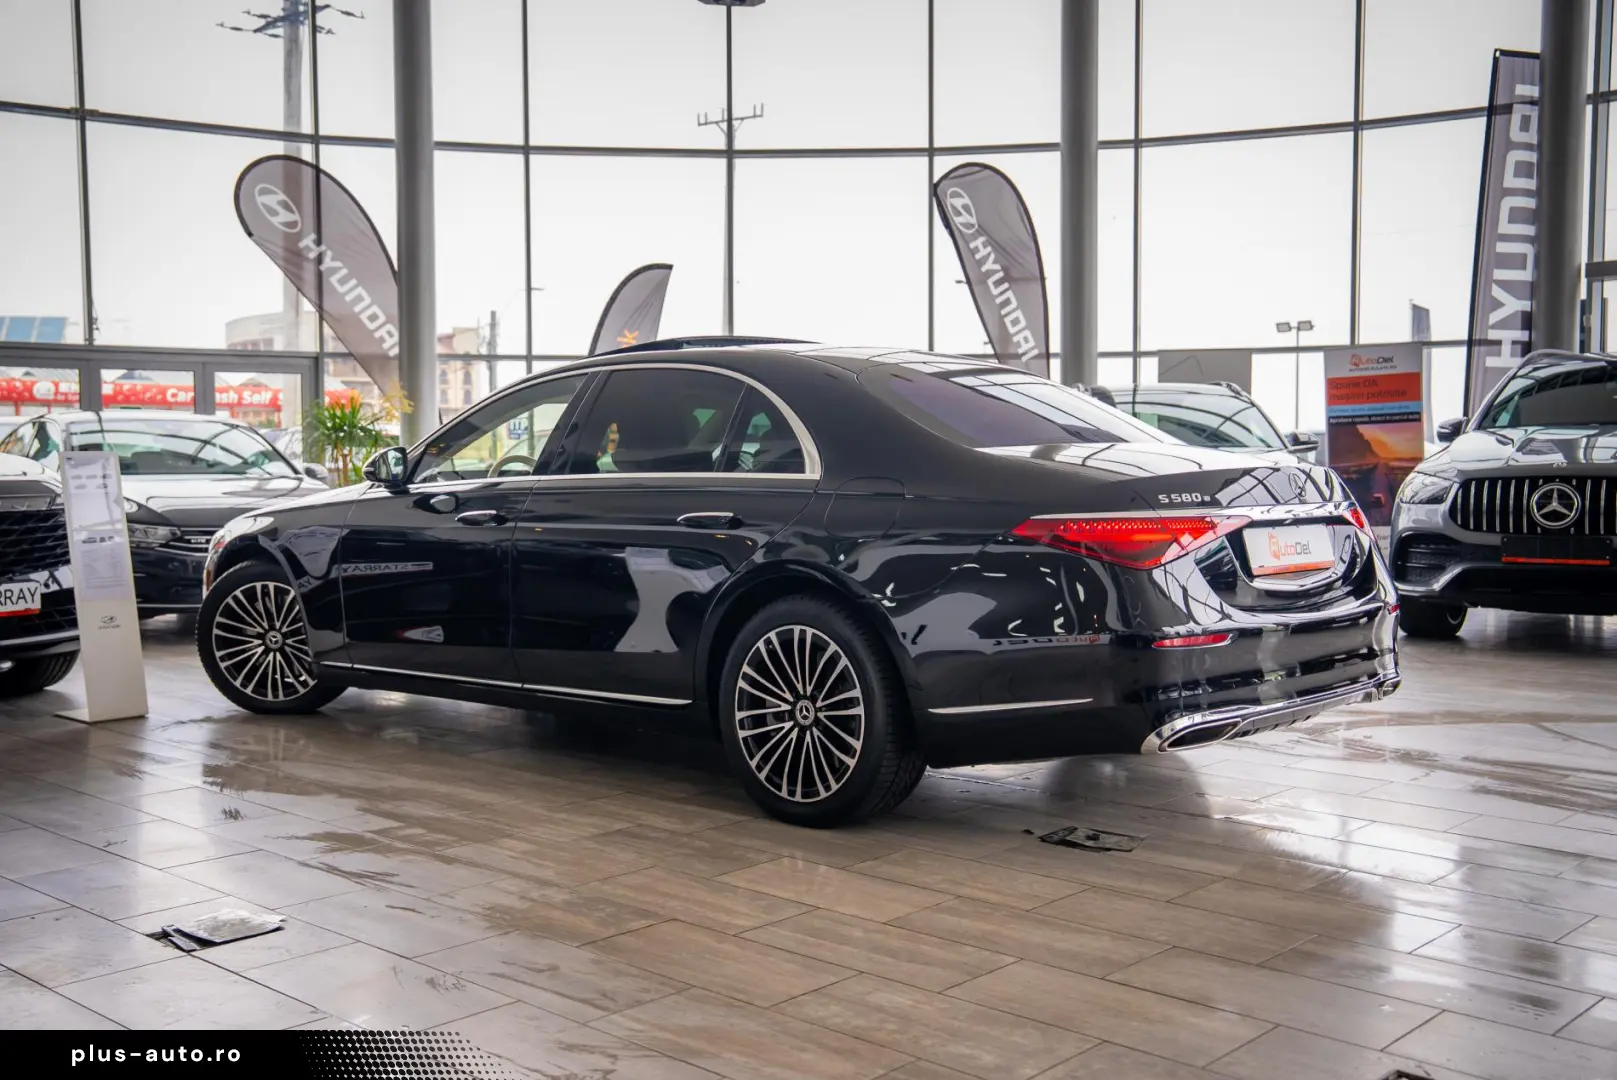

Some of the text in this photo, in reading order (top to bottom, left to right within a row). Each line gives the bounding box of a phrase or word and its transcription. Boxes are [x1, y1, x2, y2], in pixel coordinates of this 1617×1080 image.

[1485, 83, 1539, 368] HYUNDAI
[969, 236, 1039, 362] HYUNDAI
[166, 388, 194, 402] Car
[215, 389, 239, 405] ash
[242, 391, 273, 405] Self
